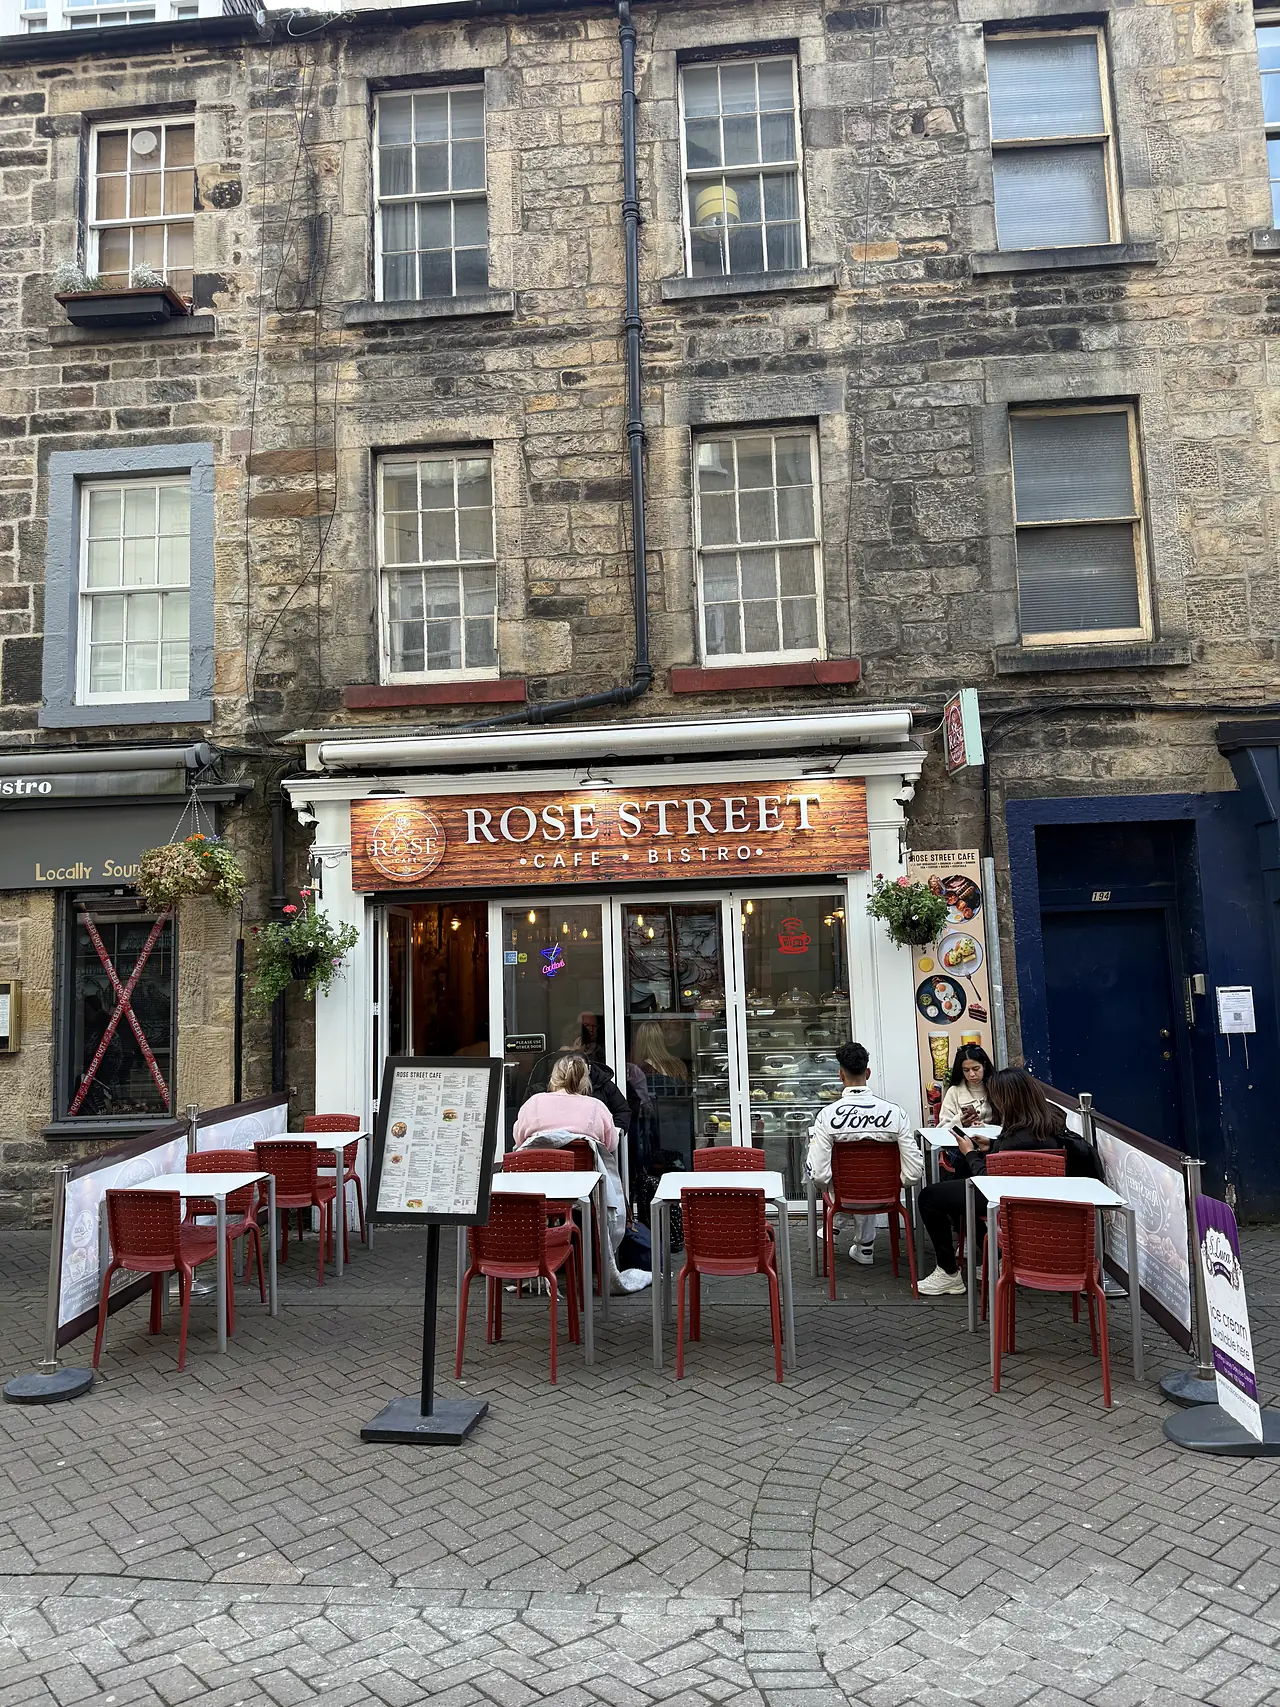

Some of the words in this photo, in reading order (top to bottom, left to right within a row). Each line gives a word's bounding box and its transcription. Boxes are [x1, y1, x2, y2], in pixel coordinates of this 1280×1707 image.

[462, 804, 600, 845] ROSE
[617, 793, 821, 838] STREET
[372, 837, 439, 857] ROSE
[648, 845, 751, 864] BISTRO
[533, 851, 601, 869] CAFE
[911, 854, 928, 862] ROSE
[930, 853, 955, 862] STREET
[957, 852, 975, 861] CAFE
[35, 862, 93, 881] Locally
[1093, 892, 1109, 901] 194
[410, 1071, 428, 1079] STREET
[830, 1103, 892, 1129] Ford
[1208, 1300, 1221, 1323] ice
[1223, 1313, 1248, 1342] cream
[1212, 1327, 1236, 1352] available
[1236, 1343, 1250, 1361] here
